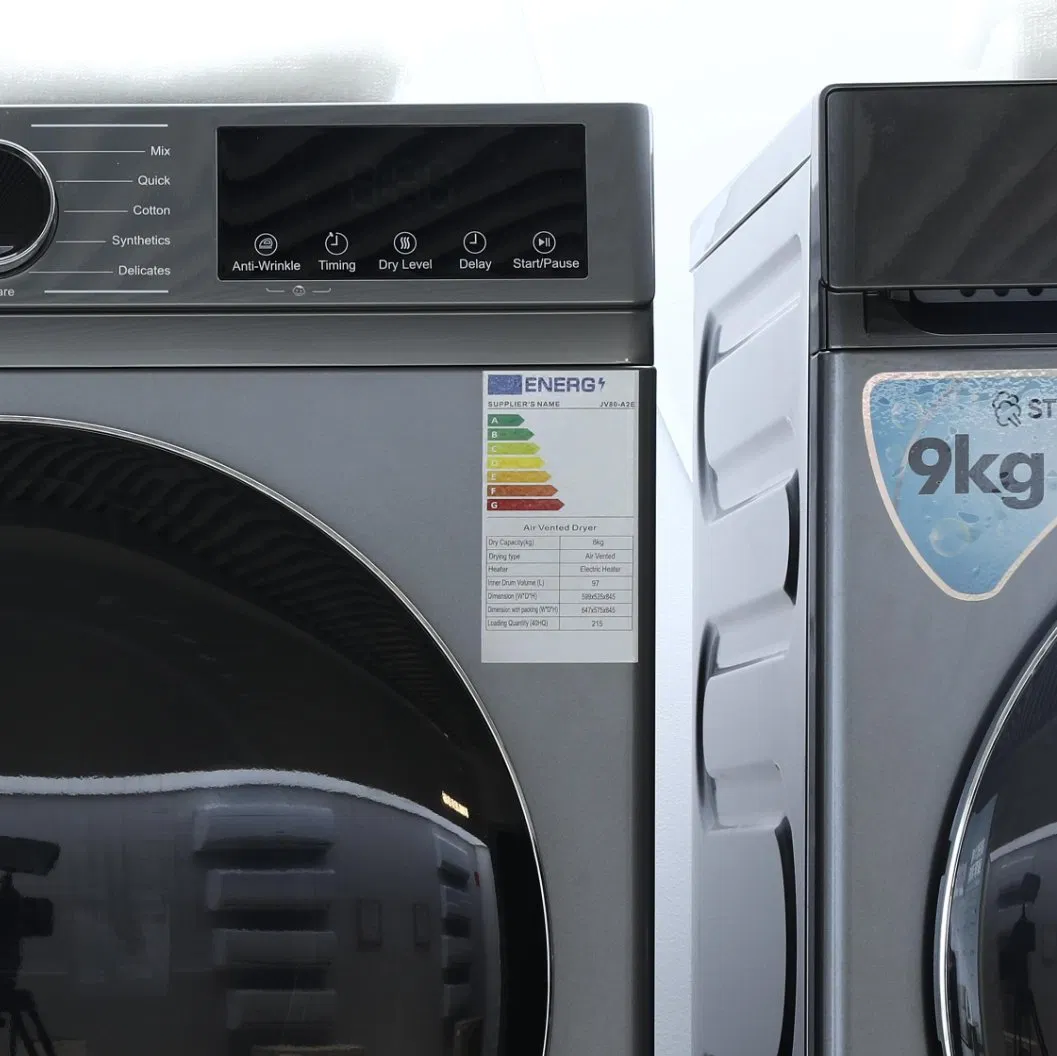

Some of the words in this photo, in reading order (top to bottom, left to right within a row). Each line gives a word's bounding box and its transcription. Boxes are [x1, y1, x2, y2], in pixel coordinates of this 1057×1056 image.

[150, 146, 171, 156] Mix
[138, 175, 171, 187] Quick
[133, 205, 171, 216] Cotton
[112, 235, 171, 248] Synthetics
[232, 260, 301, 271] Anti-Wrinkle
[318, 260, 356, 273] Timing
[379, 259, 402, 272] Dry
[405, 259, 433, 270] Level
[459, 258, 492, 272] Delay
[513, 258, 580, 269] Start/Pause
[118, 265, 171, 276] Delicates
[525, 377, 595, 392] ENERG
[1028, 399, 1057, 419] ST
[908, 434, 1045, 510] 9kg
[572, 524, 597, 533] Dryer
[489, 553, 507, 561] Drying
[508, 553, 520, 561] type
[488, 620, 507, 628] Loading
[508, 620, 529, 628] Quantity
